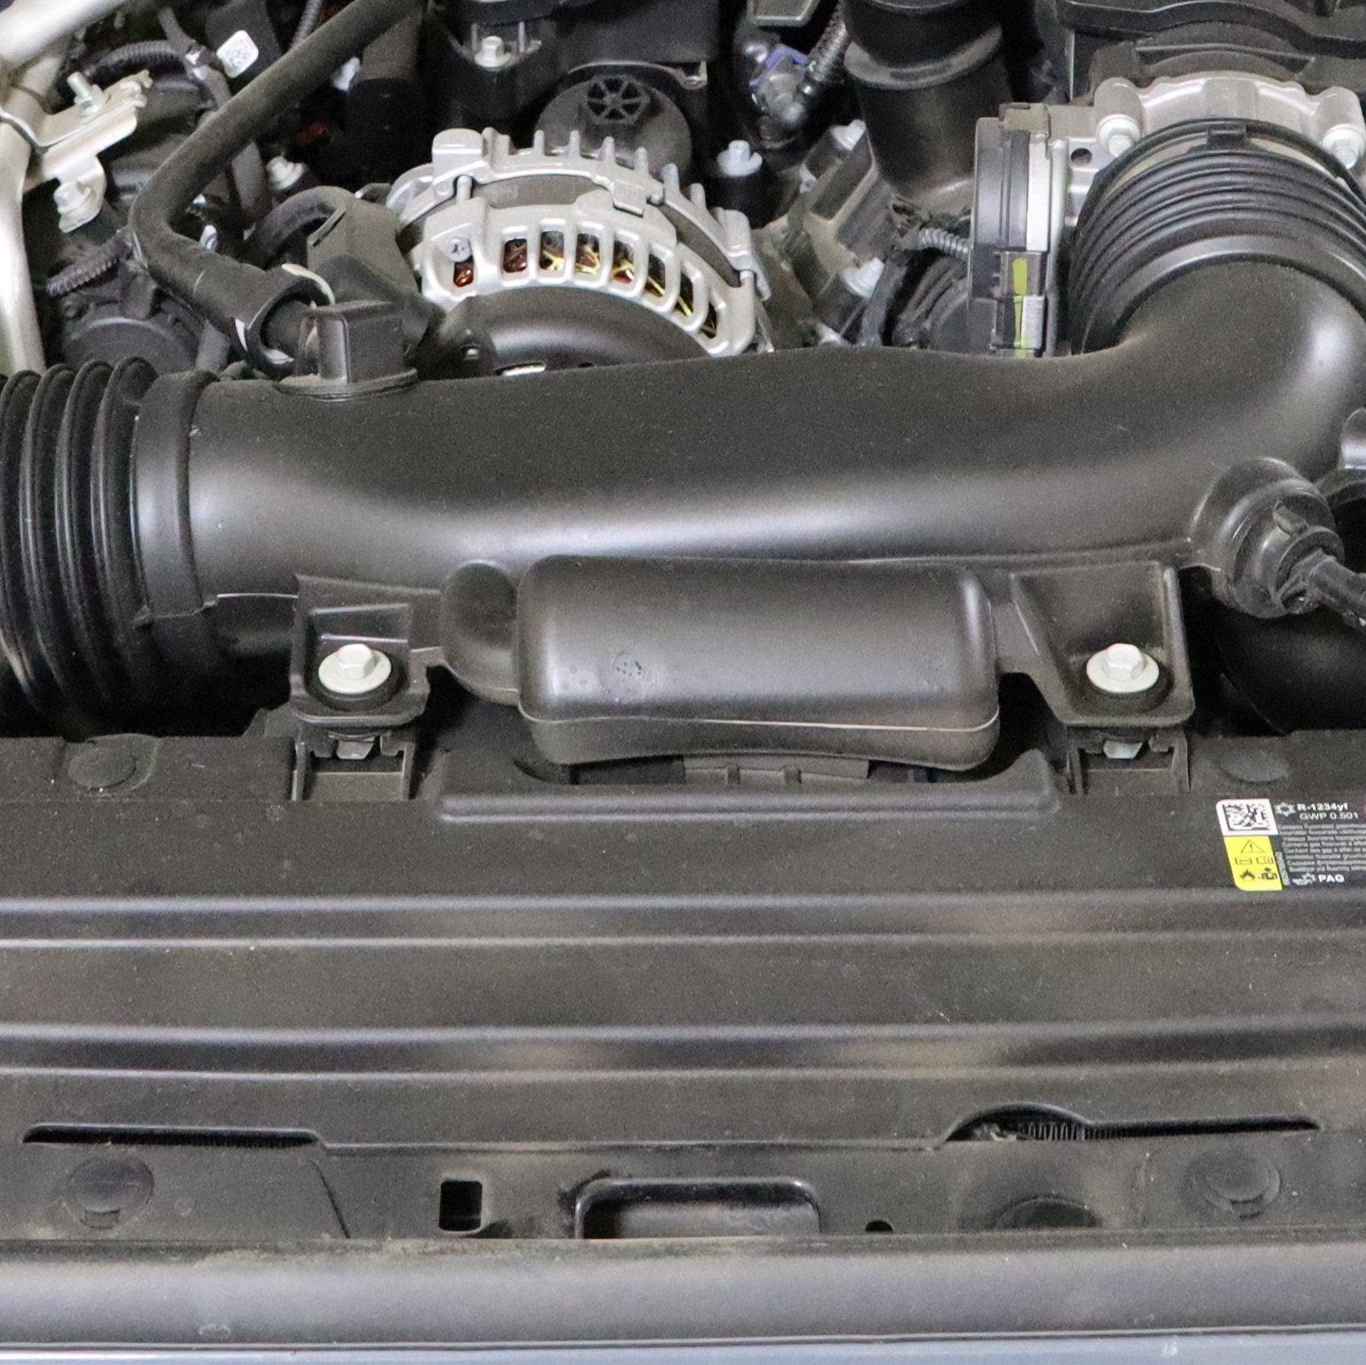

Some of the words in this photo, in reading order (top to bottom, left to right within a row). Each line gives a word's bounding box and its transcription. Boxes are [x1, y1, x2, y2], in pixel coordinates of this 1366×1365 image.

[1297, 802, 1348, 812] R-1234yf
[1299, 811, 1327, 820] GWP
[1318, 874, 1345, 883] PAG
